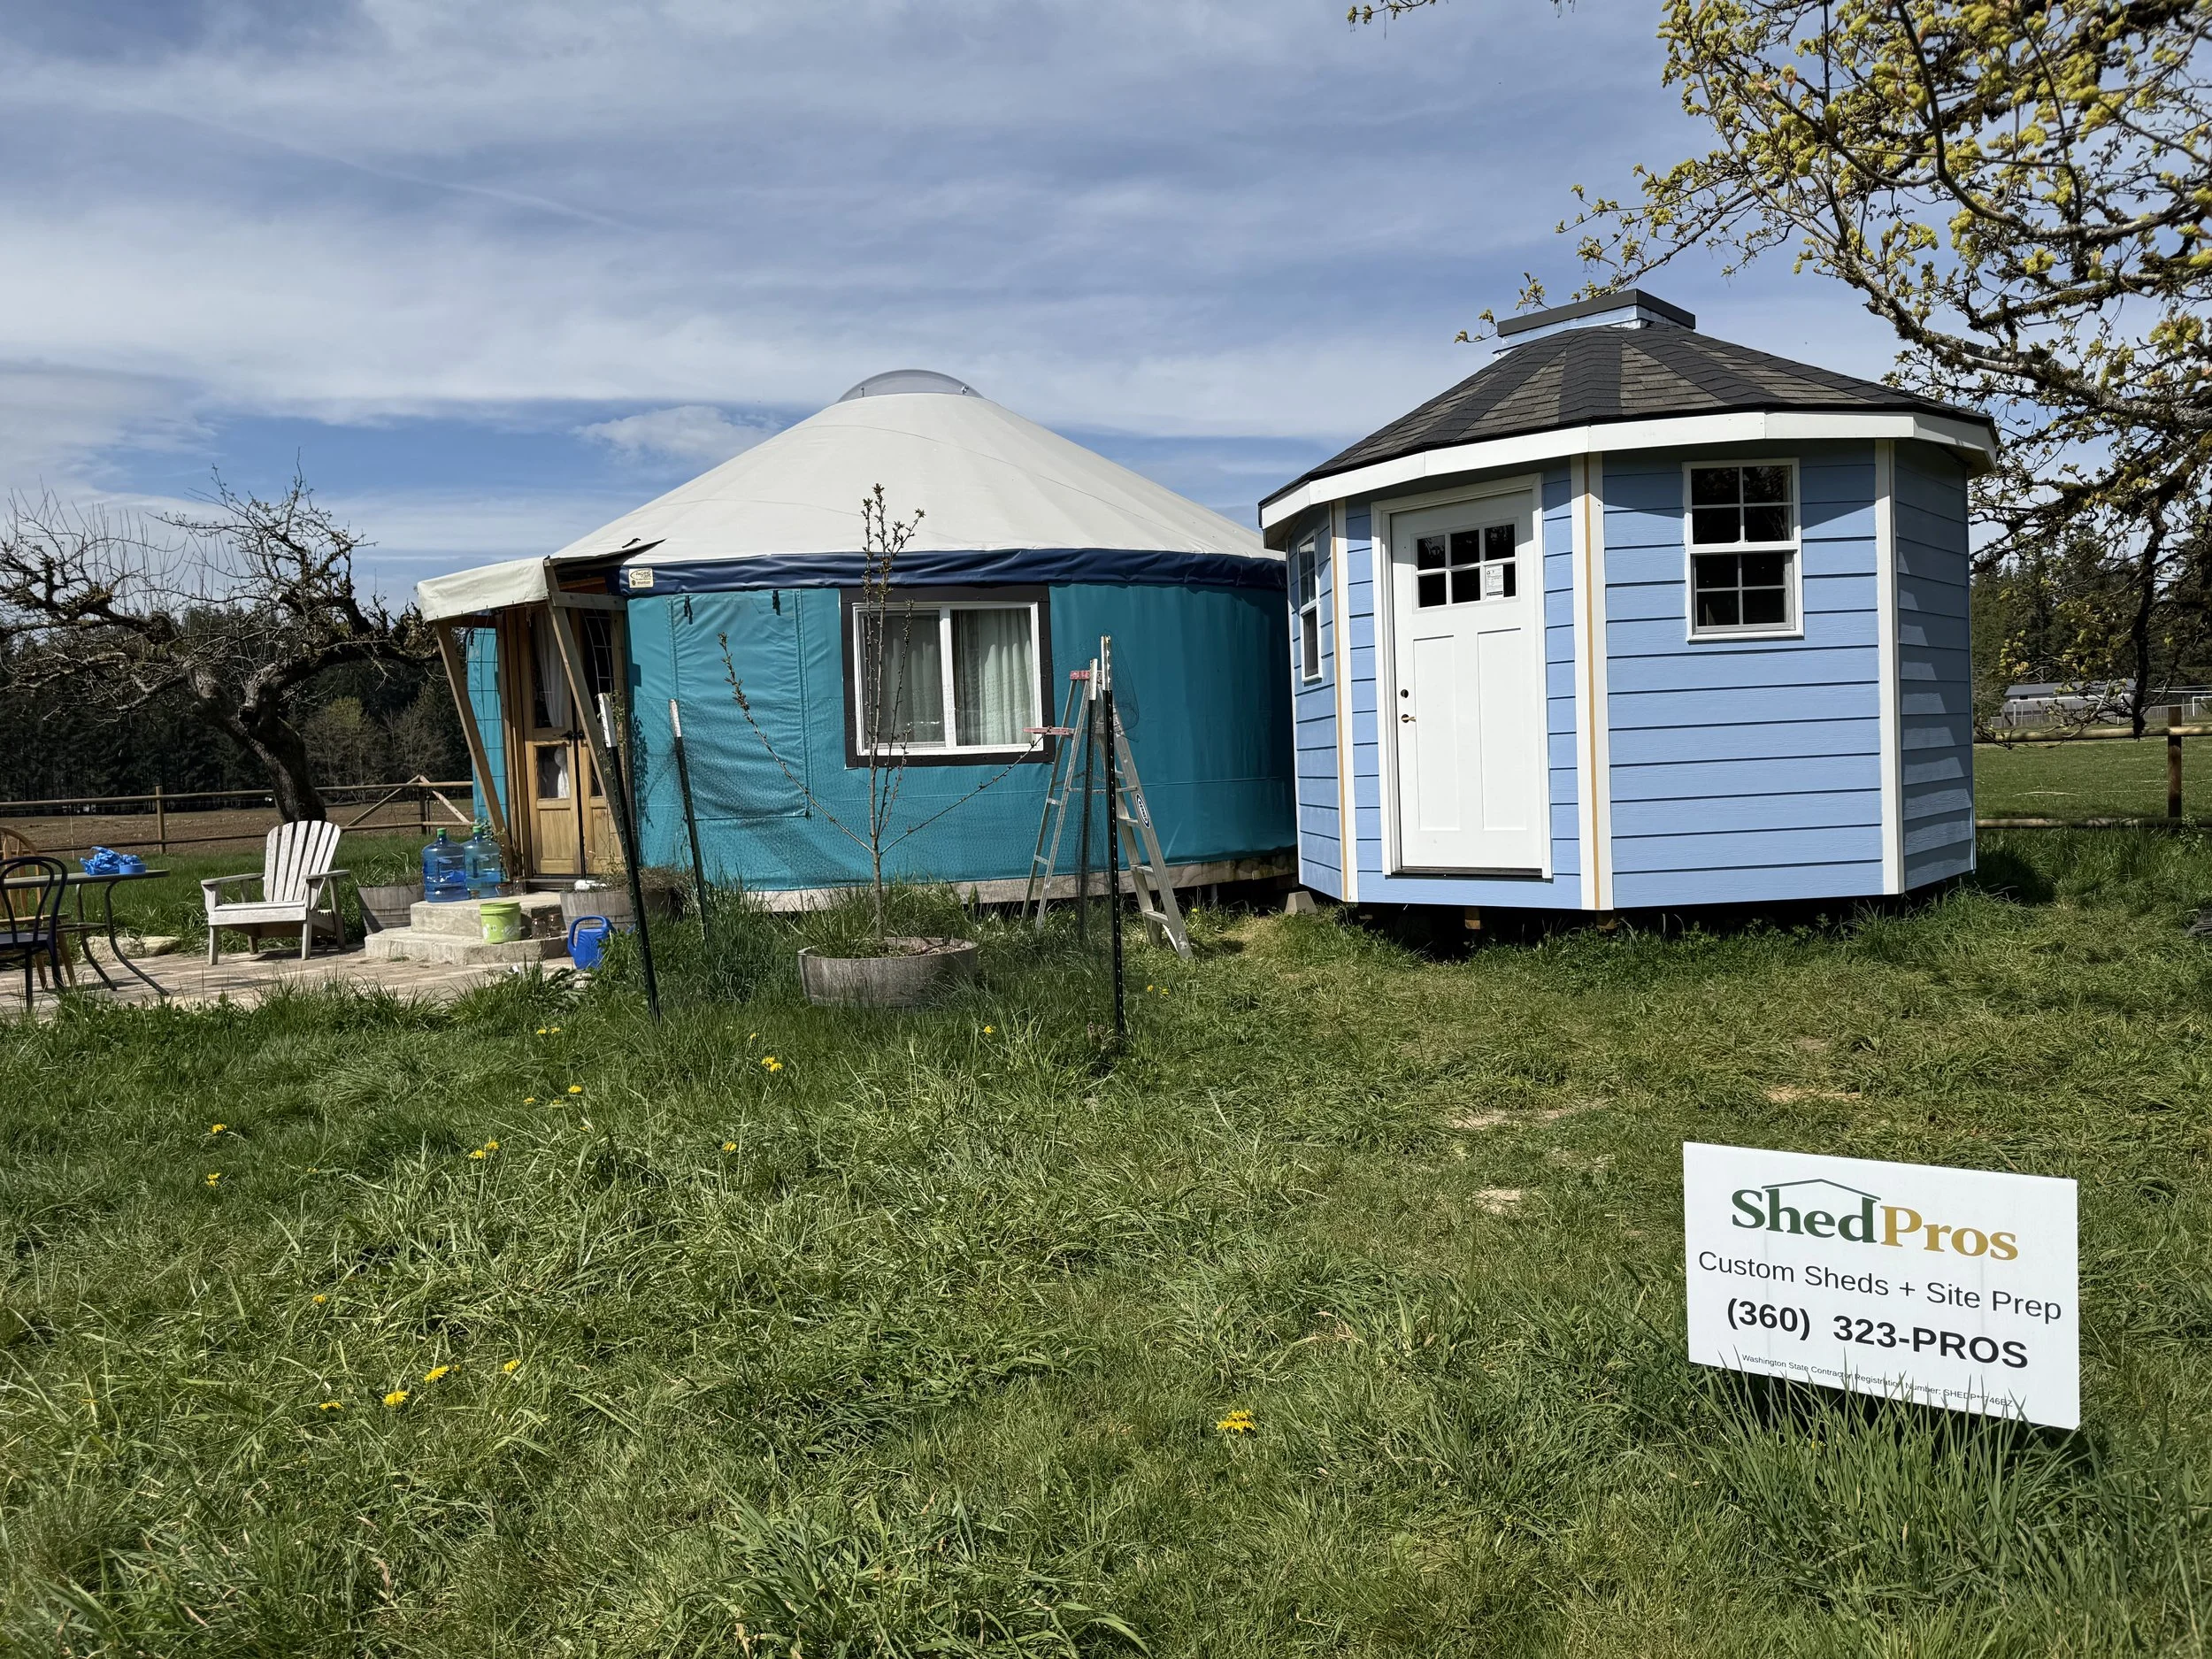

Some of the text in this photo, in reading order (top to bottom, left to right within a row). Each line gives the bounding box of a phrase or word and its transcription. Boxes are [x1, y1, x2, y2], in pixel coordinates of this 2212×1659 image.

[1732, 1187, 2018, 1261] ShedPros
[1699, 1251, 2062, 1325] Custom Sheds + Site Prep
[1727, 1297, 2029, 1370] (360) 323-PROS
[1741, 1354, 1786, 1368] Washington
[1788, 1362, 1809, 1372] State
